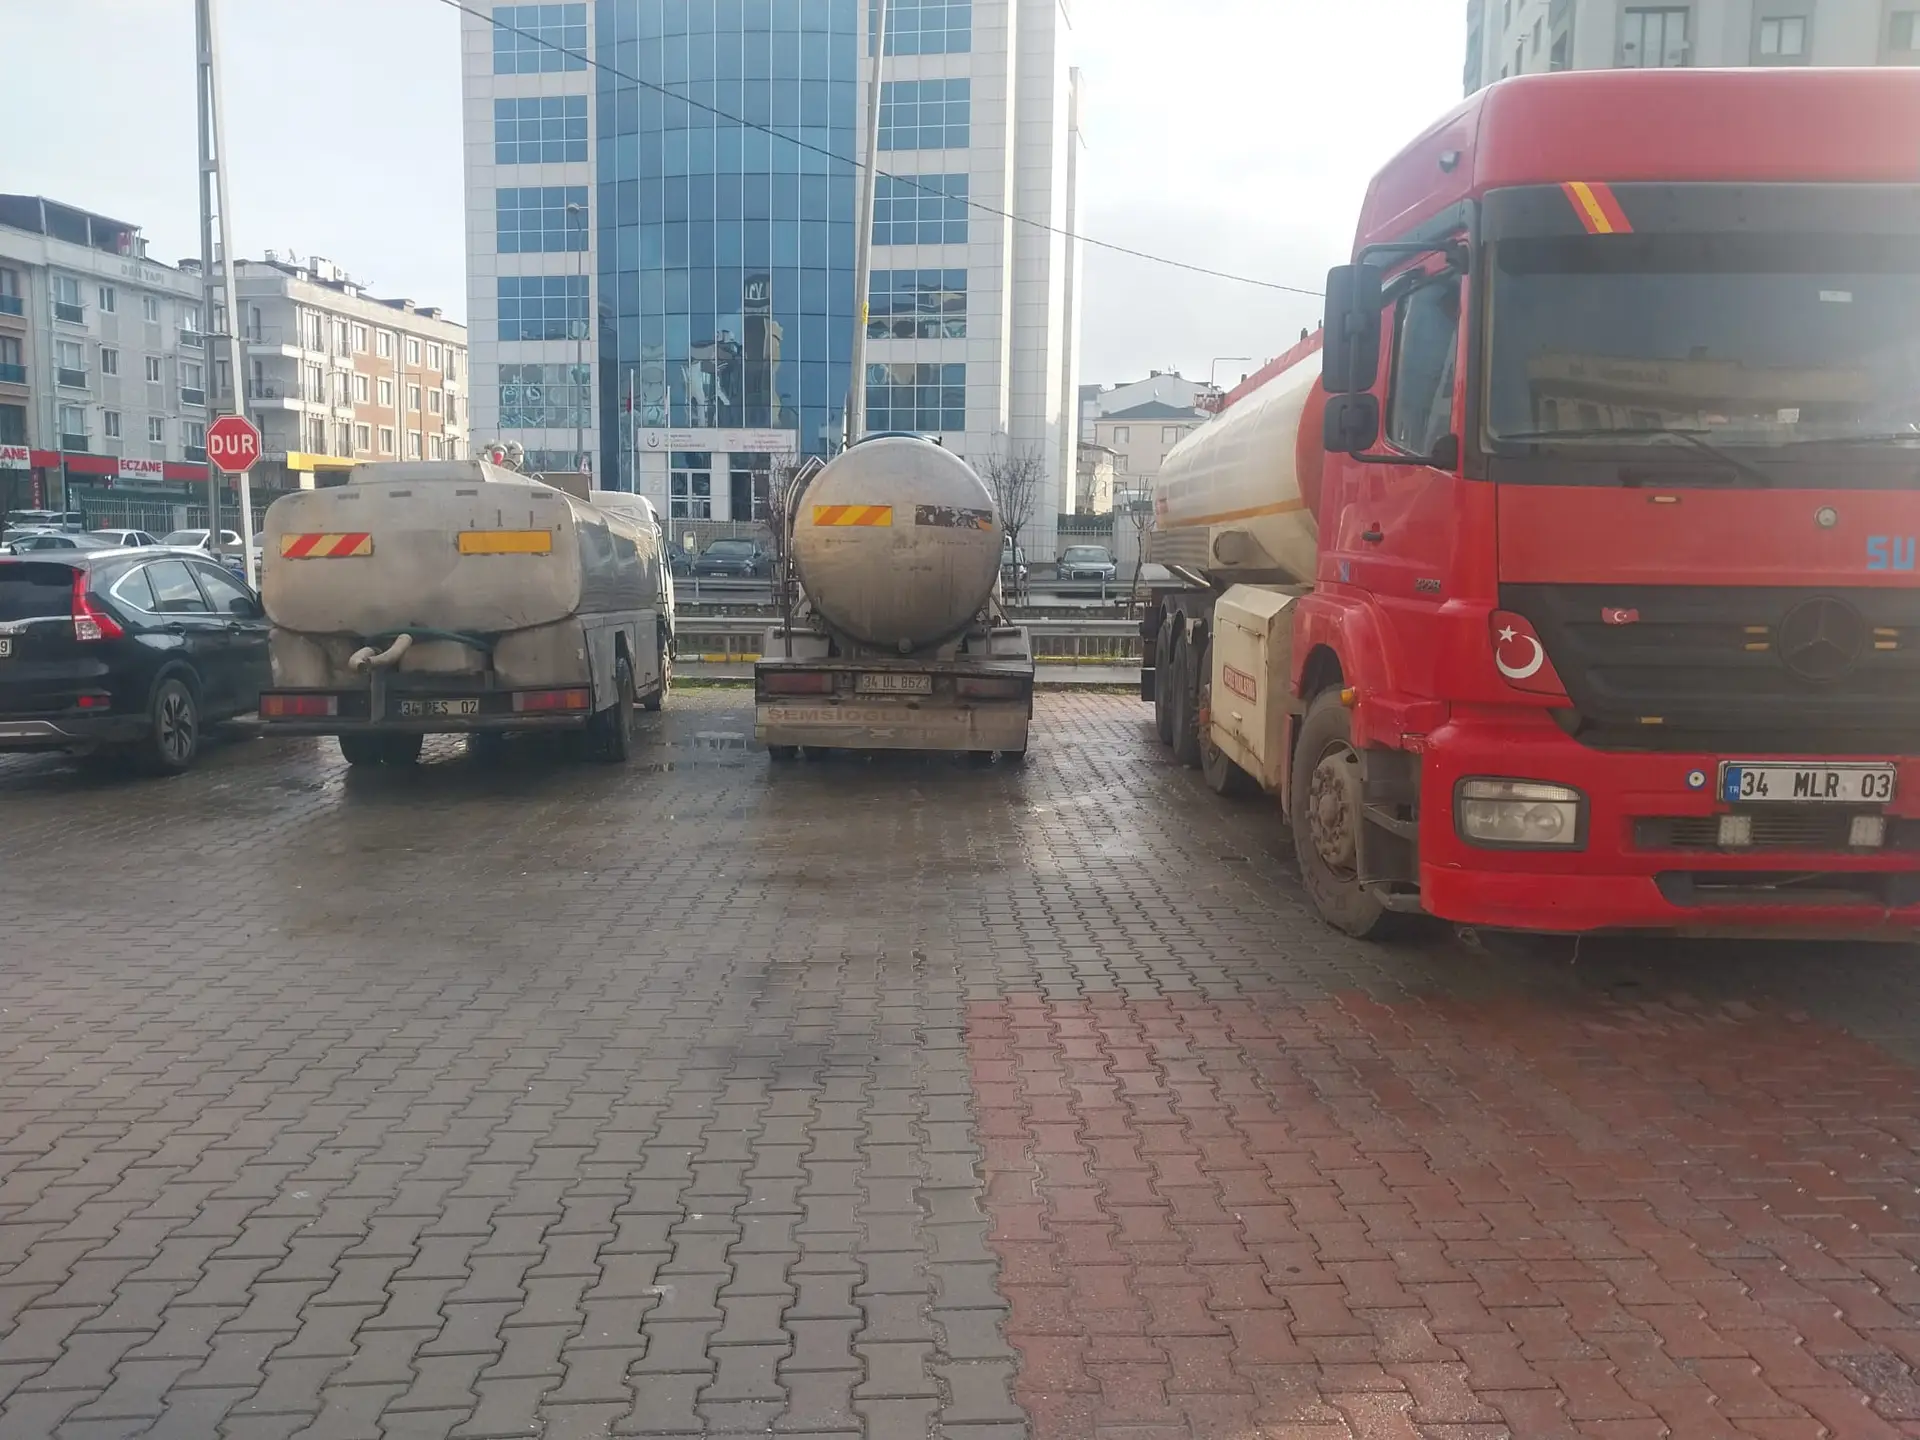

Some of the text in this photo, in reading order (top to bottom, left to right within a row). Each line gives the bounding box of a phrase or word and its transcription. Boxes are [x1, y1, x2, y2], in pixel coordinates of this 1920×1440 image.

[211, 433, 255, 455] DUR
[120, 459, 162, 473] ECZANE
[1867, 535, 1916, 570] SU
[863, 675, 878, 689] 34
[883, 675, 897, 688] UL
[461, 701, 477, 714] 02
[1741, 771, 1769, 797] 34
[1793, 772, 1840, 798] MLR
[1861, 773, 1890, 798] 03
